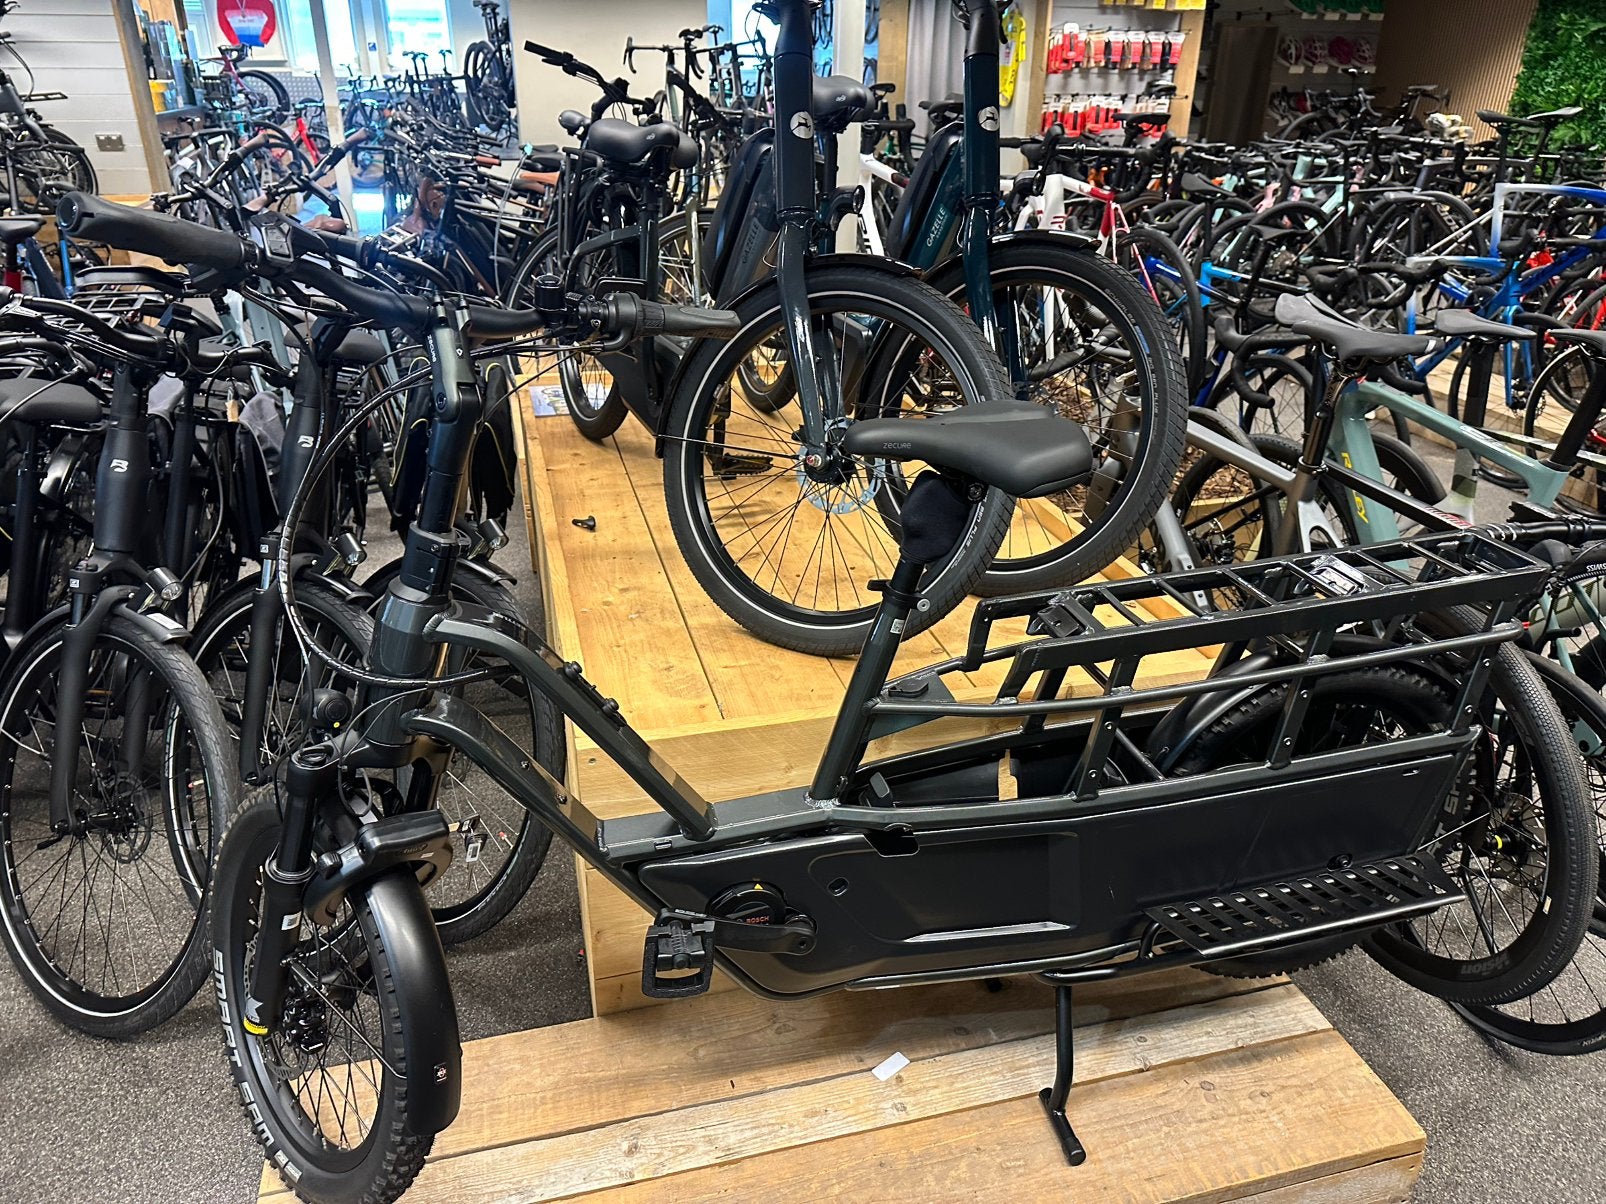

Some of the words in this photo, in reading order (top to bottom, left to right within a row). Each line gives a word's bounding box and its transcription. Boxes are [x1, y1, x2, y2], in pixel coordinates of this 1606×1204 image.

[926, 207, 946, 247] GAZELLE
[746, 916, 770, 924] BOSCH
[213, 946, 243, 1068] SMART
[238, 1080, 276, 1148] SAM
